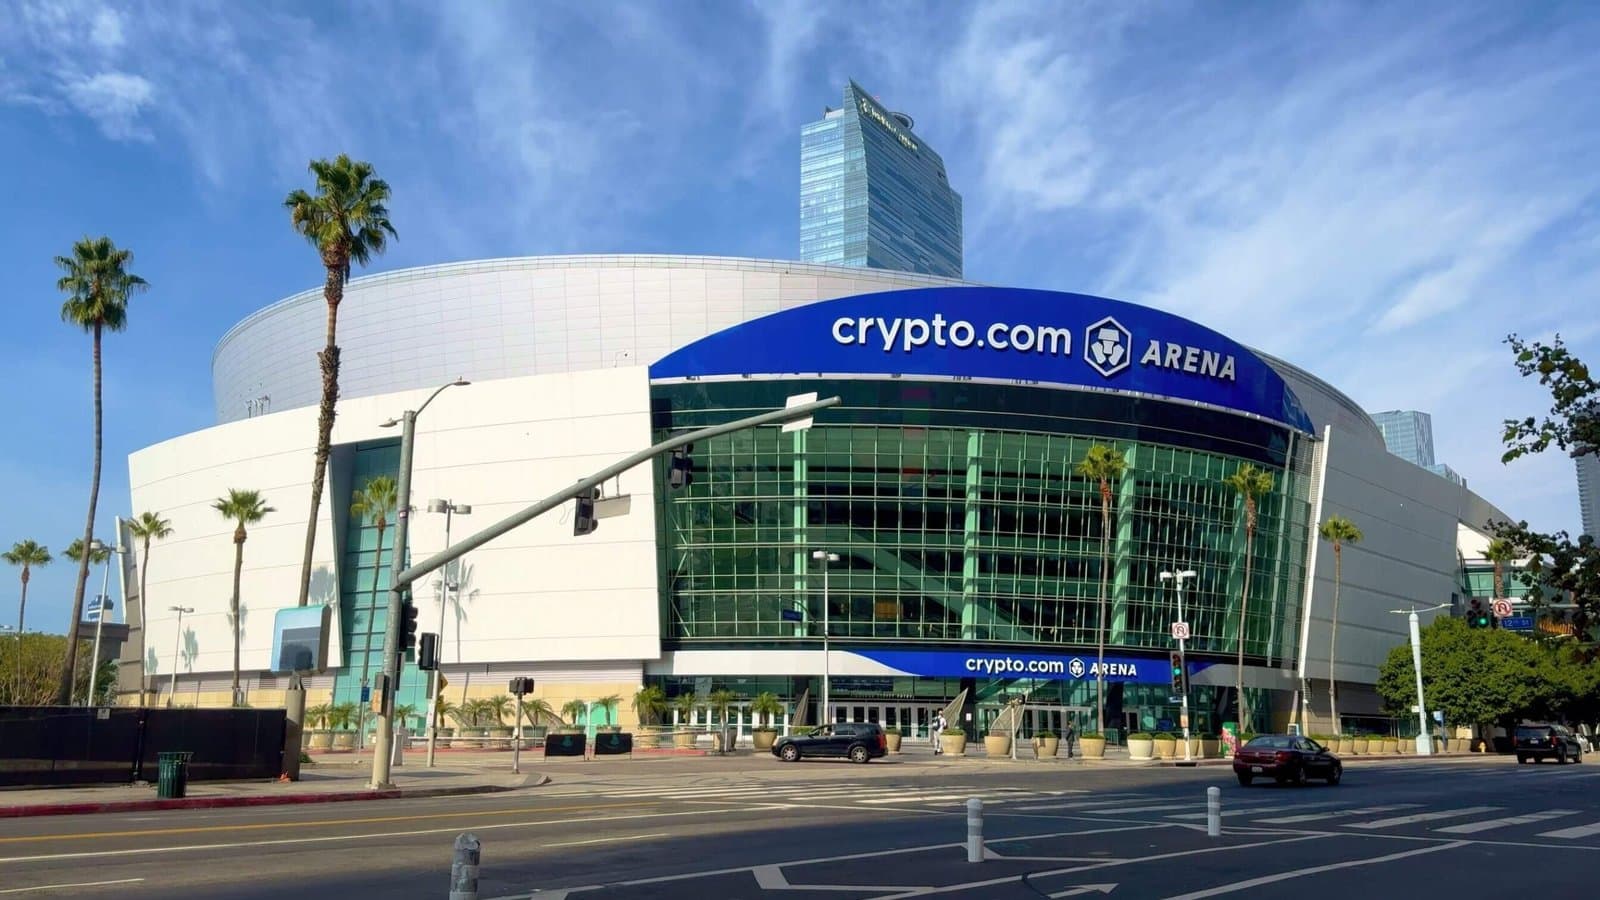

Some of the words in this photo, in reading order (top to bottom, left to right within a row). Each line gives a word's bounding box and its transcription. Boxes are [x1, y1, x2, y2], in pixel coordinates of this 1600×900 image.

[831, 313, 1071, 354] crypto.com
[1140, 339, 1237, 381] ARENA
[965, 657, 1064, 674] crypto.com
[1089, 662, 1137, 676] ARENA
